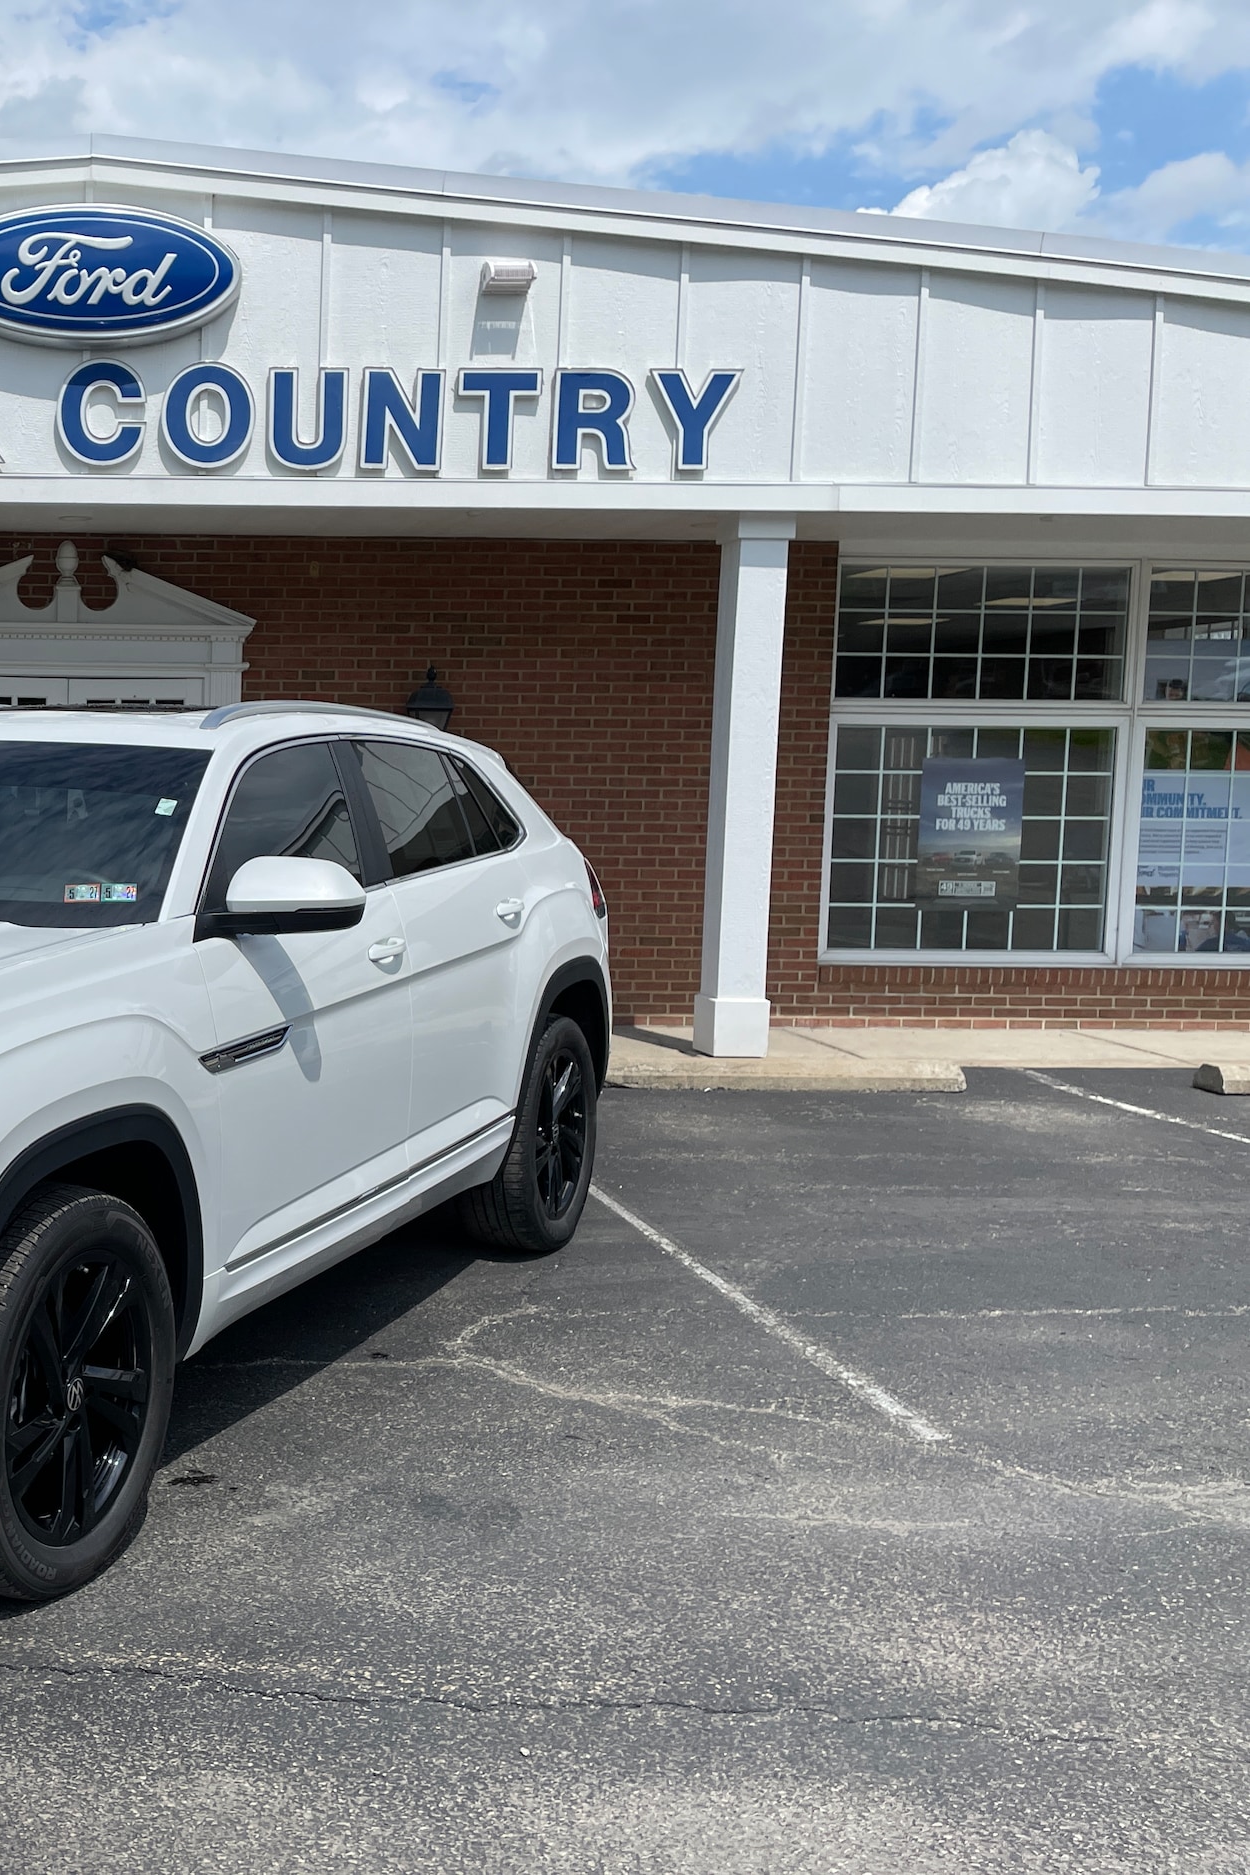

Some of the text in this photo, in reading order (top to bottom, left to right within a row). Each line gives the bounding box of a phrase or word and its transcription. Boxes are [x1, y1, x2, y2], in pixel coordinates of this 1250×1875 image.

[0, 231, 178, 306] Ford
[56, 358, 745, 470] COUNTRY
[945, 782, 1000, 795] AMERICA'S
[937, 794, 1007, 807] BEST-SELLING
[951, 806, 991, 819] TRUCKS
[935, 818, 1006, 831] FOR 49 YEARS
